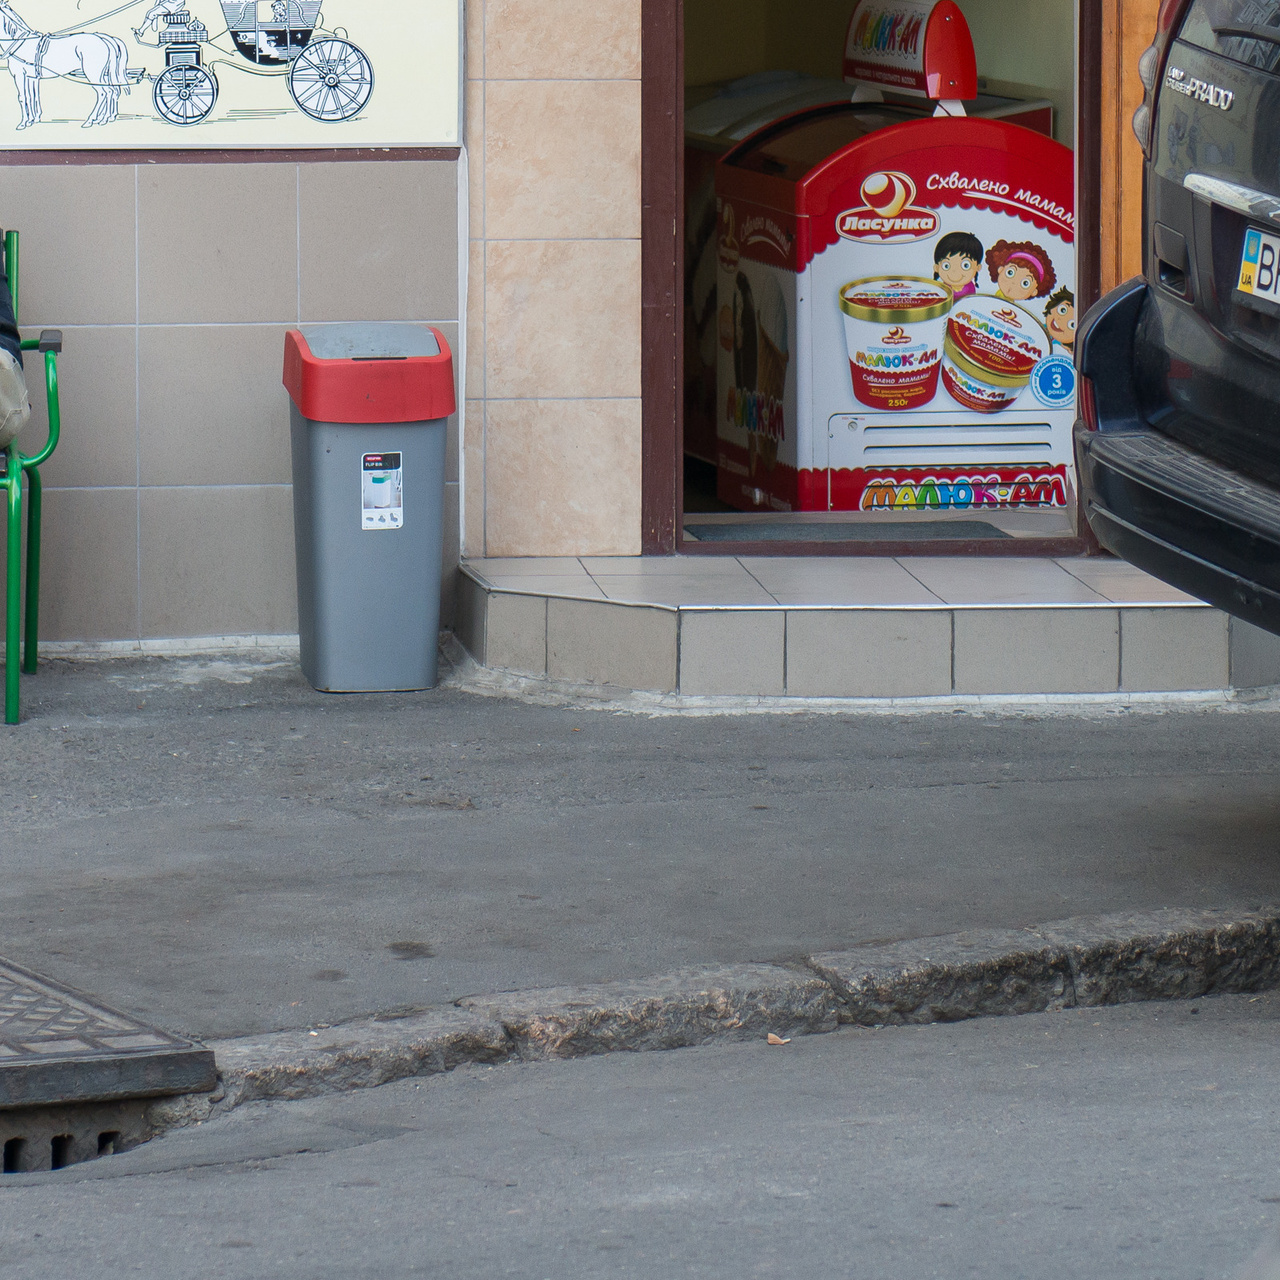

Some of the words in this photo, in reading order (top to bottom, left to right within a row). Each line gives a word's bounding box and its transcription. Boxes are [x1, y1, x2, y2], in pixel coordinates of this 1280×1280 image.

[1188, 78, 1234, 111] PRADO
[926, 171, 1009, 195] Схвалено
[842, 216, 934, 235] Ласунка
[1241, 272, 1252, 286] UA
[965, 330, 1010, 353] Схвалено
[863, 373, 895, 384] Схвалено
[1052, 374, 1062, 389] 3
[1047, 388, 1066, 396] років
